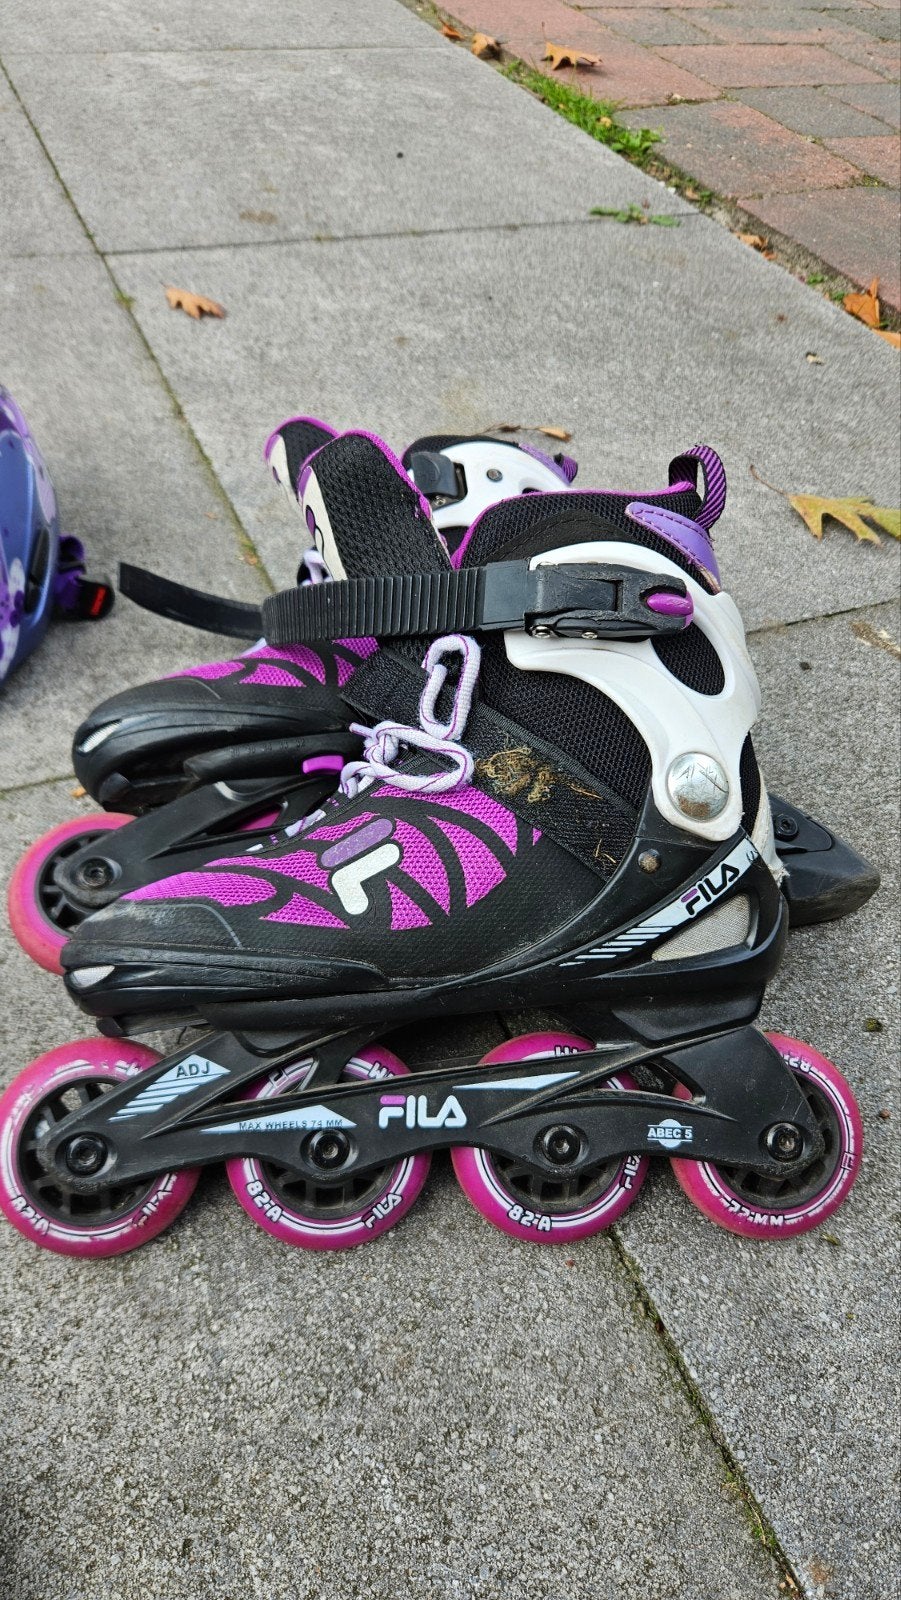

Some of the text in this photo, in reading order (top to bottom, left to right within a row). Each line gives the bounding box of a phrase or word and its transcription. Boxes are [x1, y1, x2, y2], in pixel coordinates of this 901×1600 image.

[681, 863, 740, 915] FILA
[176, 1061, 210, 1078] ADJ
[378, 1094, 467, 1129] FILA
[239, 1122, 261, 1131] MAX
[265, 1120, 308, 1130] WHEELS
[327, 1119, 343, 1127] MM
[647, 1128, 693, 1139] ABEC 5
[361, 1192, 402, 1228] FILA
